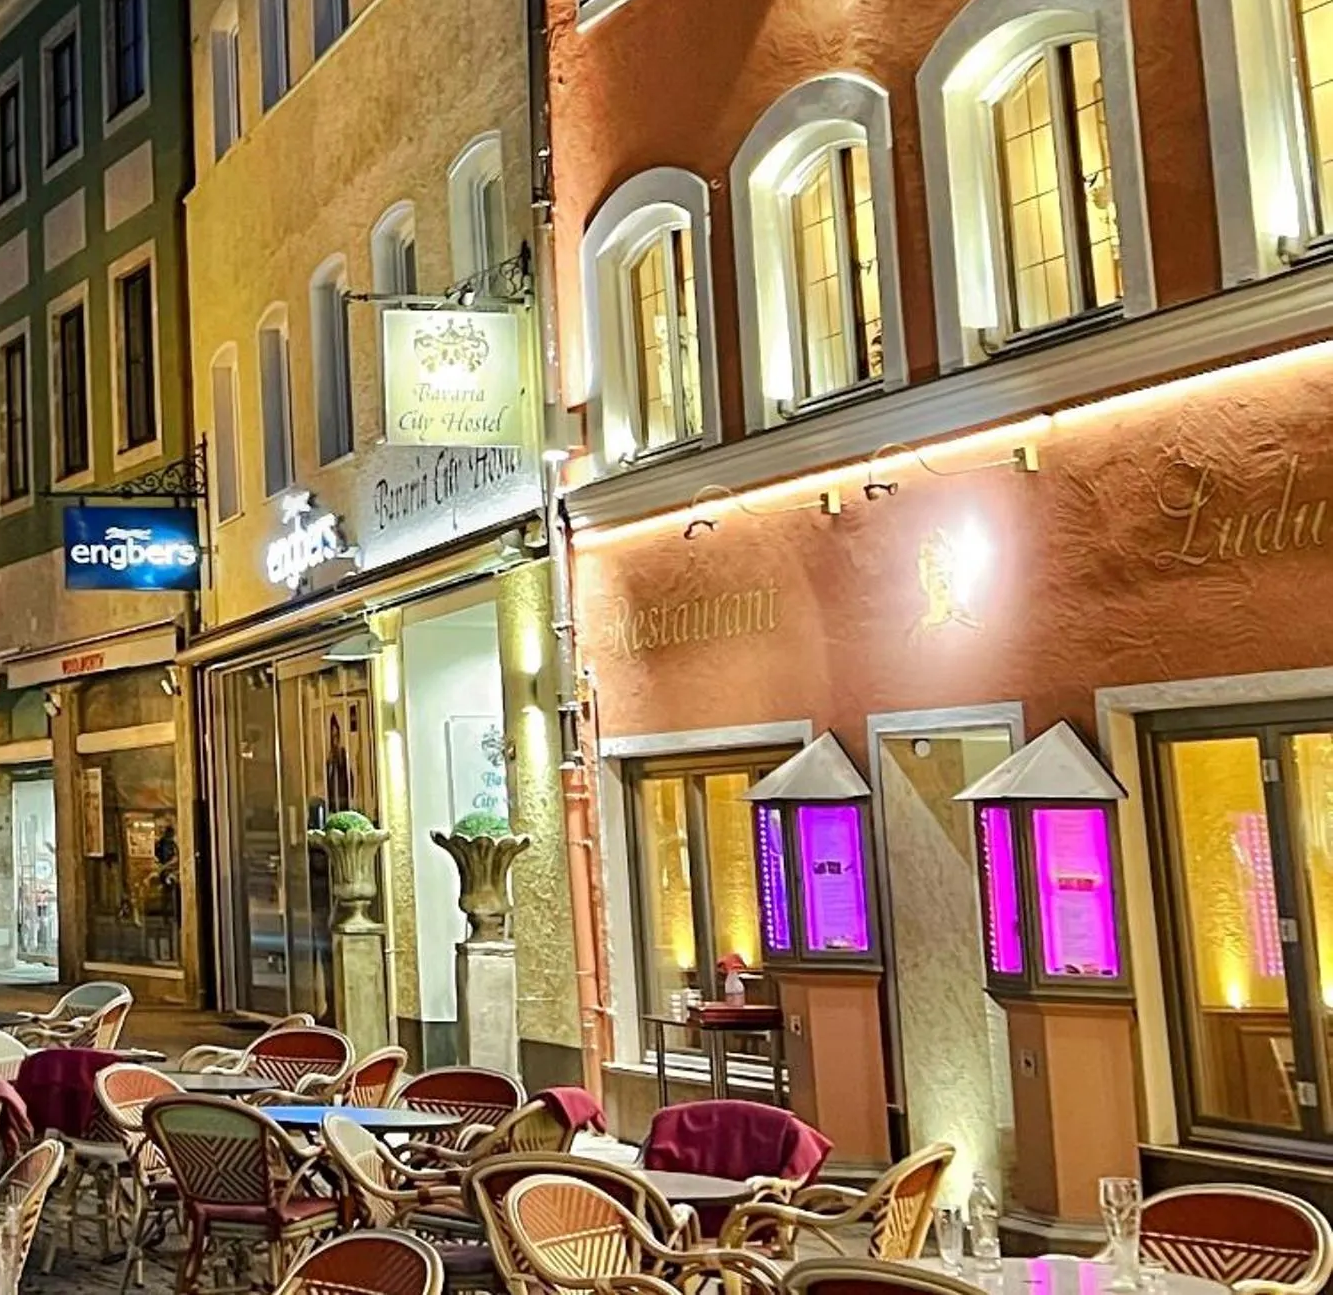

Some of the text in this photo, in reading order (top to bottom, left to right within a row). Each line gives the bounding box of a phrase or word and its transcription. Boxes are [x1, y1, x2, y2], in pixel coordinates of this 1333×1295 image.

[412, 382, 485, 403] Bavaria
[398, 405, 509, 441] City Hostel
[70, 537, 198, 571] engbers
[605, 577, 779, 661] Restaurant
